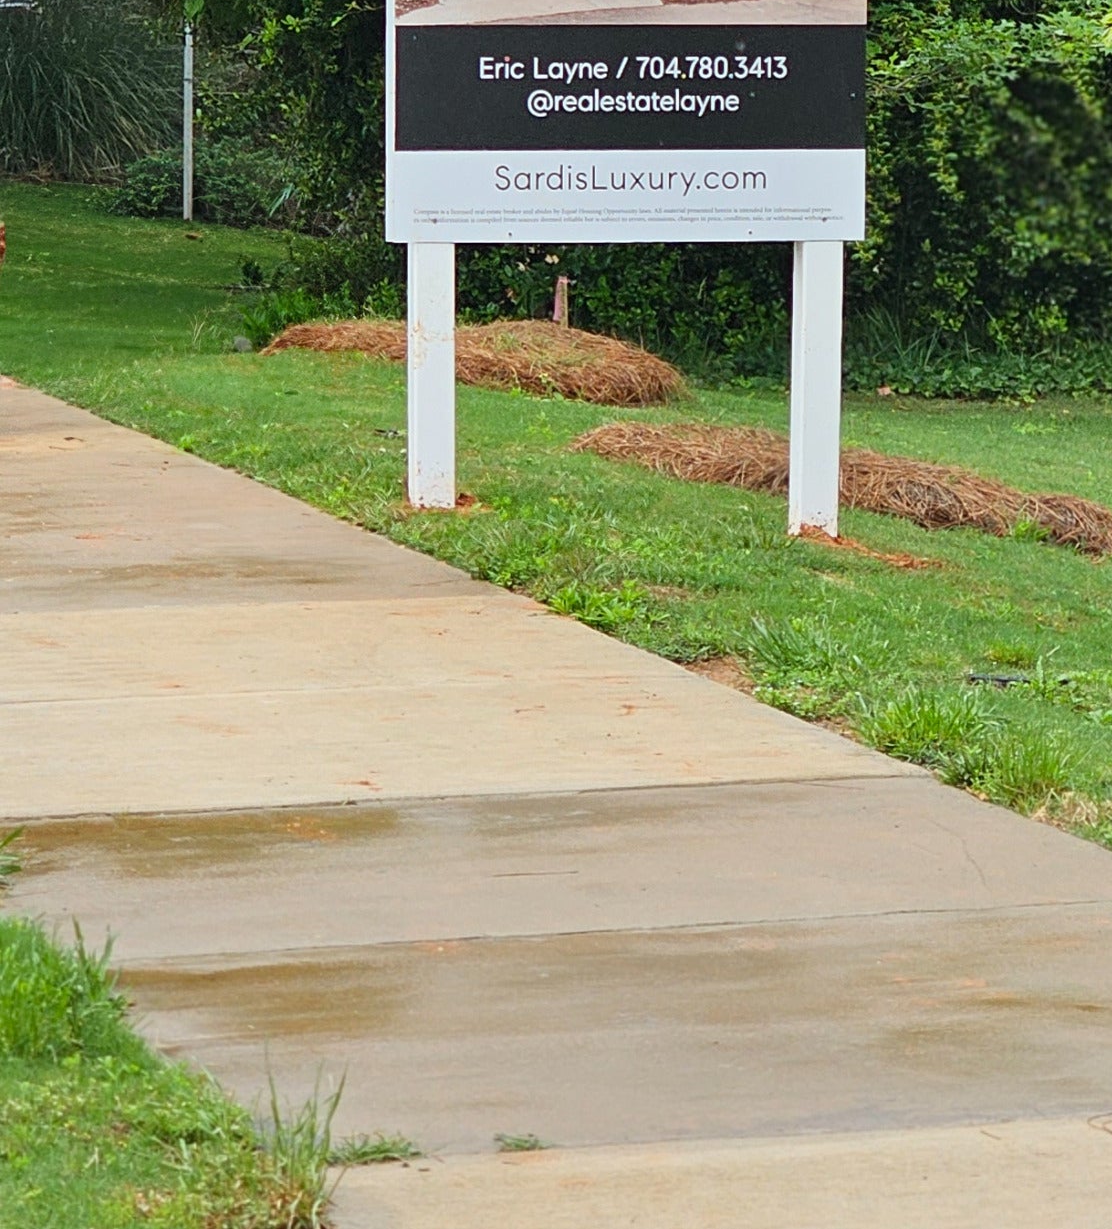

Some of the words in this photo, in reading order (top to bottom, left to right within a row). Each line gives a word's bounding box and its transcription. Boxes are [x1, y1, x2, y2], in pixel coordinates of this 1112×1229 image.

[479, 56, 525, 80] Eric
[533, 56, 609, 85] Layne
[616, 56, 629, 80] /
[635, 55, 788, 80] 704.780.3413
[527, 88, 740, 118] @realestatelayne
[495, 164, 767, 197] SardisLuxury.com
